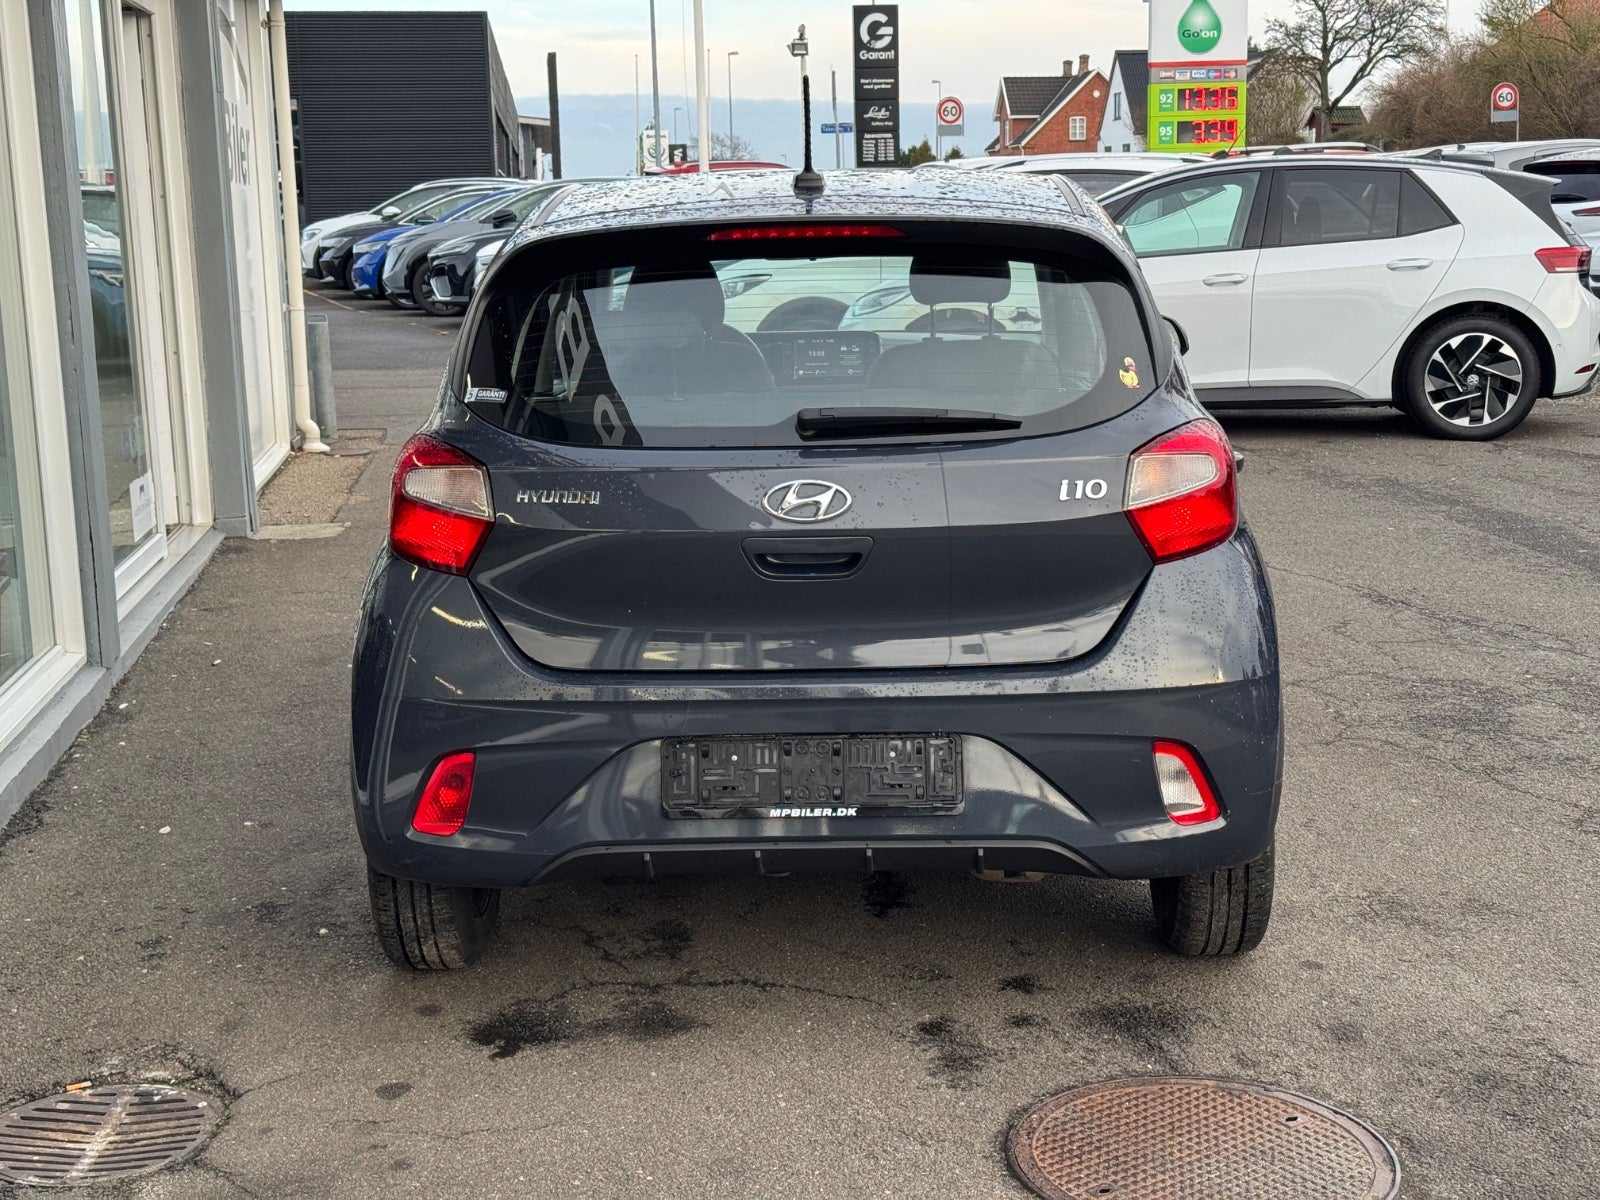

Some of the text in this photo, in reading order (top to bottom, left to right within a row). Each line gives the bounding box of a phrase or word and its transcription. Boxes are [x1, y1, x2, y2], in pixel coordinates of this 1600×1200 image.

[1182, 29, 1217, 38] Go'on
[859, 49, 895, 60] Garant
[1160, 94, 1173, 103] 92
[1498, 92, 1513, 102] 60
[943, 106, 958, 116] 60
[1159, 127, 1172, 136] 95
[516, 489, 600, 504] HYUNDAI
[769, 808, 858, 818] MPBILER.DK
